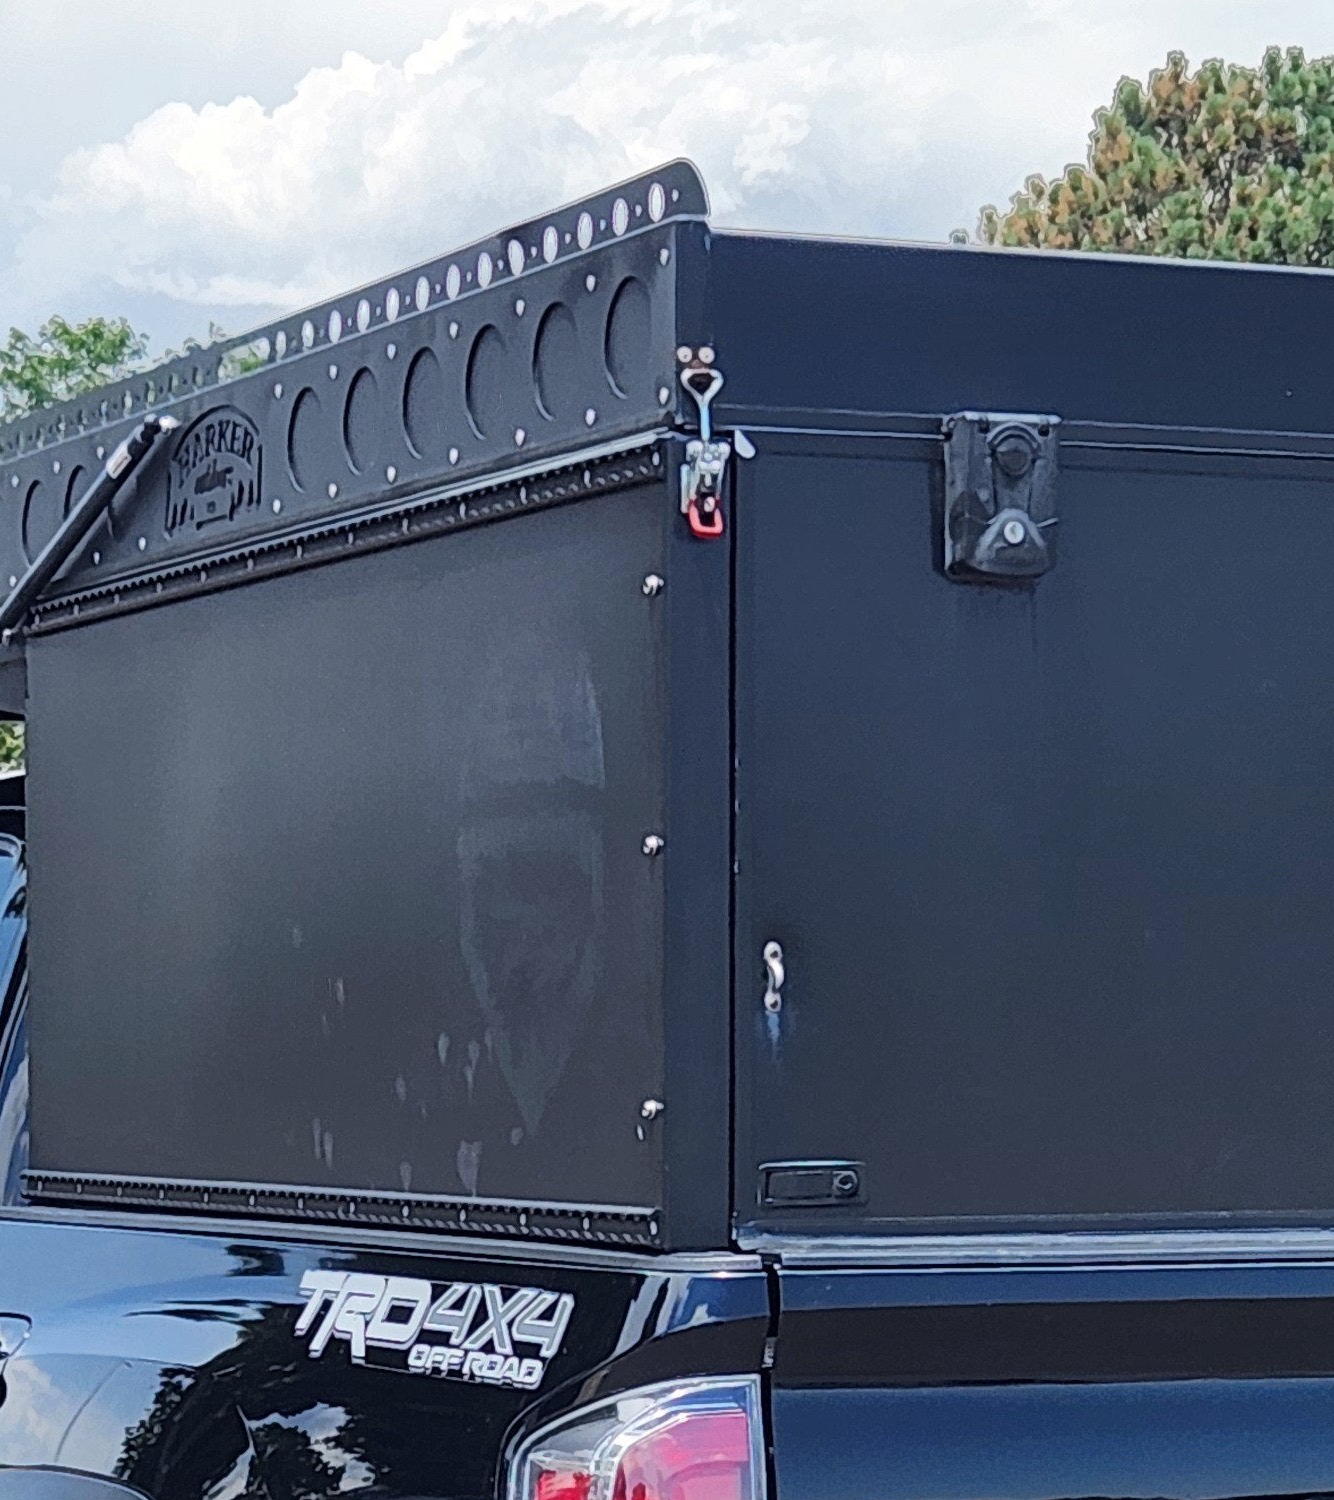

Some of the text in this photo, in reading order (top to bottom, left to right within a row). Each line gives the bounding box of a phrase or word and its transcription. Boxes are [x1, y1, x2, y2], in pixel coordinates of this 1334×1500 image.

[294, 1270, 433, 1364] TRD
[407, 1343, 545, 1390] OFF ROAD
